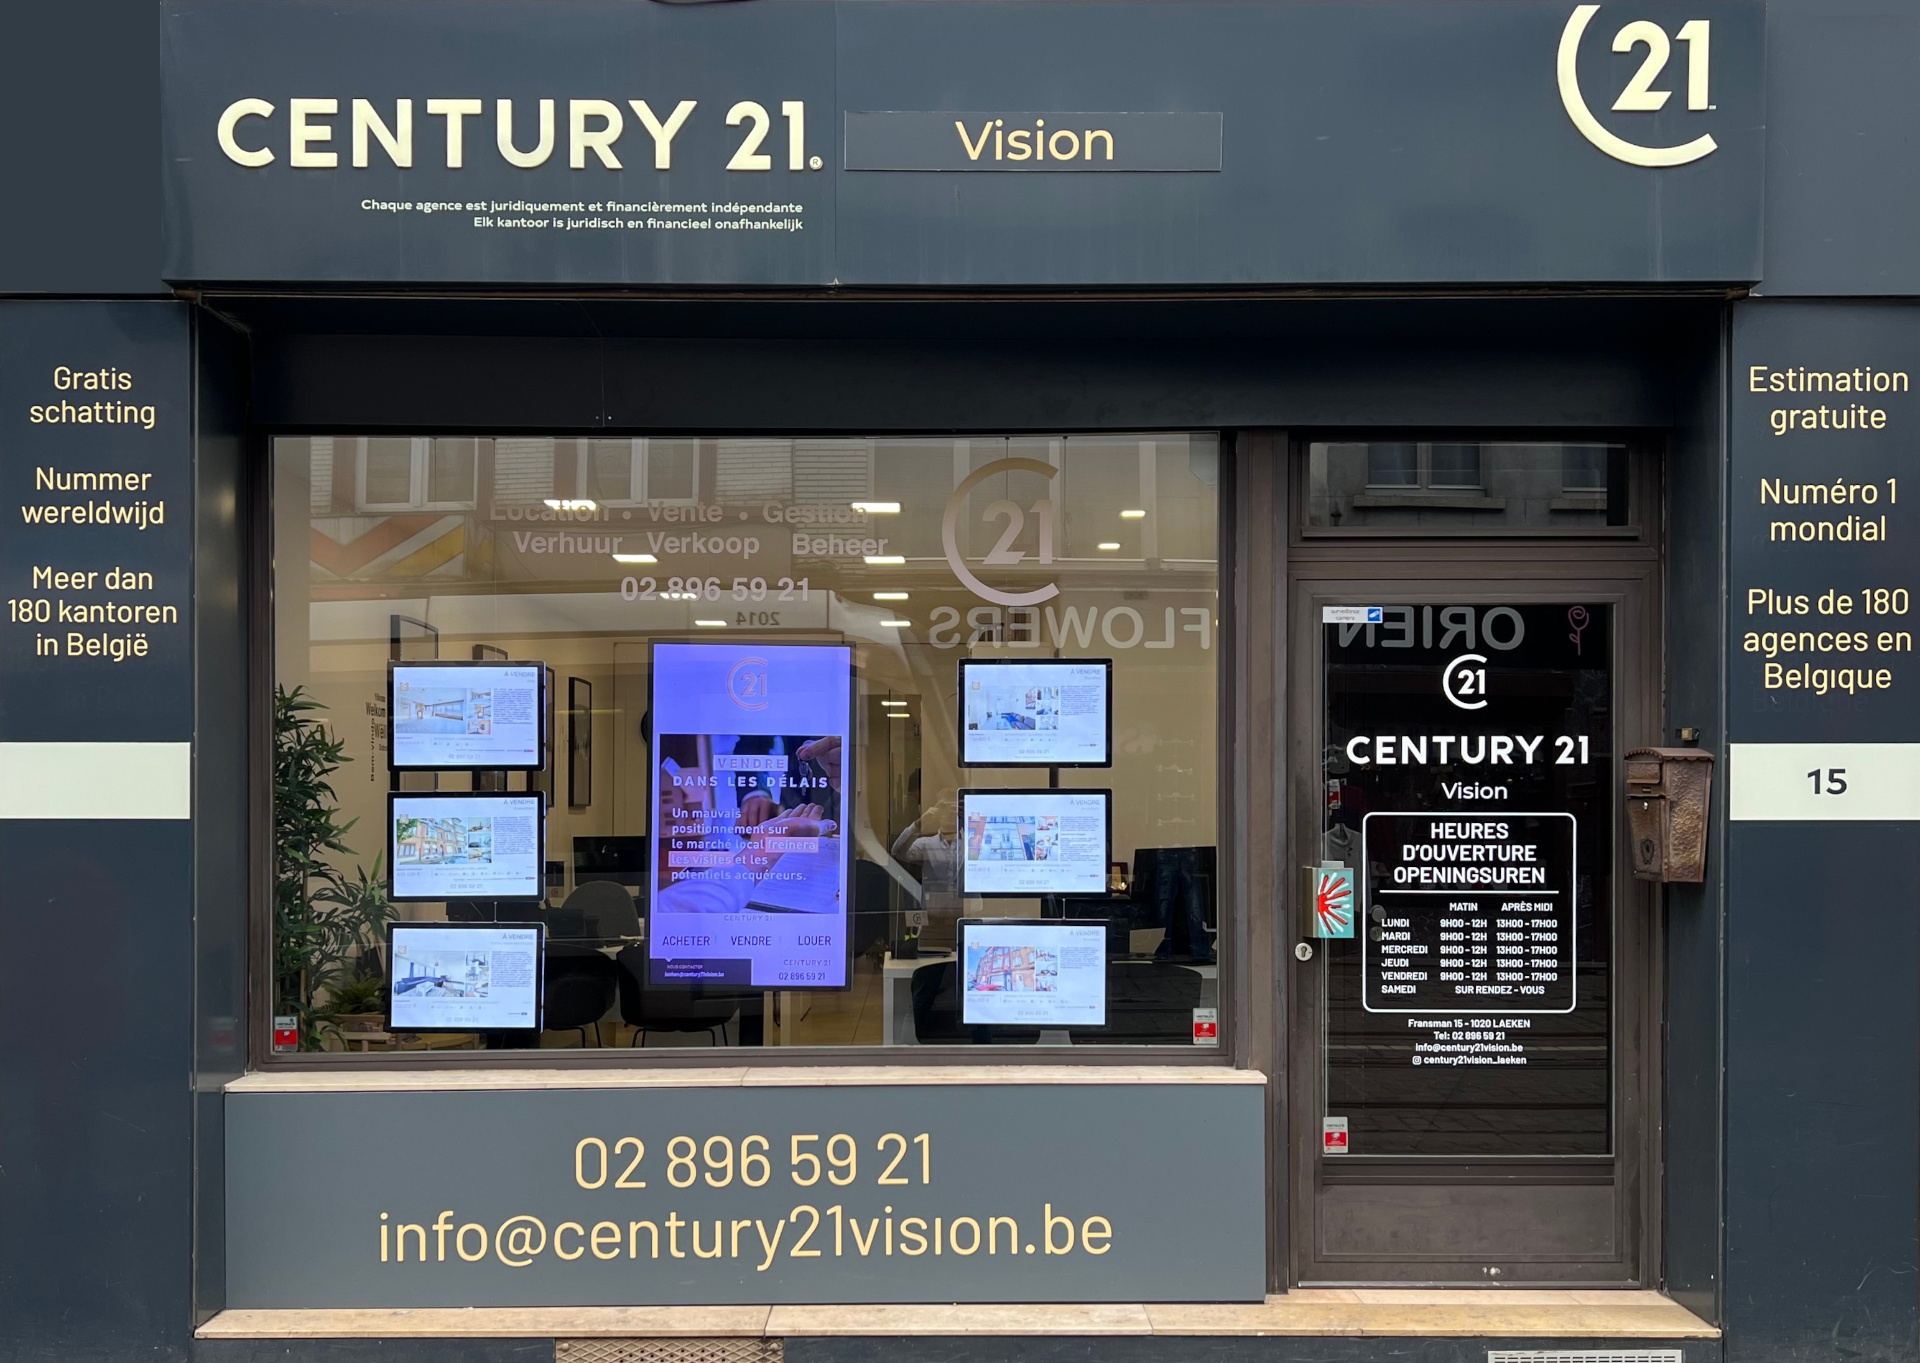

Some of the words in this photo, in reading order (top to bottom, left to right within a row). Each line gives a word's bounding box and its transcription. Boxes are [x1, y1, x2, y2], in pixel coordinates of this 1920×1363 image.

[217, 97, 699, 169] CENTURY
[955, 119, 1113, 160] Vision
[362, 199, 412, 212] Chaque
[416, 202, 462, 213] agence
[466, 201, 487, 210] est
[490, 201, 584, 214] juridiquement
[589, 202, 602, 211] et
[606, 201, 707, 212] financièrement
[712, 202, 803, 215] indépendante
[474, 217, 493, 227] Elk
[498, 217, 549, 227] kantoor
[553, 218, 563, 227] is
[566, 217, 623, 230] juridisch
[647, 218, 711, 229] financieel
[715, 219, 803, 231] onafhankelijk
[55, 367, 131, 390] Gratis
[1750, 367, 1908, 391] Estimation
[30, 400, 154, 429] schatting
[1771, 404, 1886, 435] gratuite
[37, 467, 151, 490] Nummer
[1761, 478, 1877, 504] Numéro
[1887, 479, 1895, 503] 1
[22, 501, 163, 530] wereldwijd
[490, 502, 609, 522] Location
[648, 503, 723, 522] Vente
[762, 504, 868, 524] Gestion
[1771, 515, 1885, 541] mondial
[513, 532, 623, 554] Verhuur
[647, 532, 760, 559] Verkoop
[792, 534, 888, 556] Beheer
[34, 566, 98, 589] Meer
[105, 567, 152, 589] dan
[620, 577, 657, 601] 02
[667, 577, 720, 601] 896
[731, 577, 767, 601] 59
[777, 577, 810, 601] 21
[1749, 589, 1809, 614] Plus
[1818, 589, 1852, 614] de
[1862, 589, 1908, 614] 180
[8, 599, 50, 622] 180
[59, 600, 176, 623] kantoren
[37, 633, 58, 655] in
[68, 633, 148, 661] België
[1744, 633, 1868, 658] agences
[1878, 632, 1911, 651] en
[1347, 736, 1544, 765] CENTURY
[1555, 736, 1588, 764] 21
[717, 758, 785, 769] VENDRE
[673, 776, 718, 786] DANS
[728, 777, 757, 787] LES
[766, 774, 828, 788] DÉLAIS
[1808, 769, 1847, 794] 15
[1441, 782, 1507, 799] Vision
[672, 808, 689, 818] Un
[692, 808, 741, 818] mauvais
[672, 824, 765, 835] positionnement
[1431, 823, 1508, 839] HEURES
[672, 839, 683, 849] le
[687, 839, 732, 849] marché
[735, 839, 764, 850] local
[768, 840, 816, 850] freinera
[672, 855, 690, 864] les
[693, 855, 732, 865] visites
[735, 856, 746, 865] et
[750, 855, 768, 865] les
[1403, 845, 1536, 861] D'OUVERTURE
[671, 870, 731, 882] potentiels
[735, 870, 806, 882] acquéreurs.
[1394, 867, 1544, 883] OPENINGSUREN
[1449, 903, 1478, 911] MATIN
[1501, 901, 1532, 911] APRÈS
[1534, 903, 1553, 911] MIDI
[1382, 919, 1409, 927] LUNDI
[1440, 919, 1464, 928] 9H00
[1472, 919, 1487, 928] 12H
[1496, 919, 1523, 928] 13H00
[1531, 919, 1557, 928] 17H00
[663, 936, 710, 945] ACHETER
[731, 936, 771, 945] VENDRE
[798, 936, 831, 945] LOUER
[1382, 932, 1410, 941] MARDI
[1440, 933, 1464, 941] 9H00
[1472, 933, 1487, 941] 12H
[1496, 933, 1523, 941] 13H00
[1531, 933, 1557, 941] 17H00
[1382, 945, 1428, 954] MERCREDI
[1440, 946, 1464, 954] 9H00
[1472, 946, 1487, 954] 12H
[1496, 946, 1523, 954] 13H00
[1531, 946, 1557, 954] 17H00
[1382, 959, 1409, 967] JEUDI
[1440, 959, 1464, 967] 9H00
[1472, 959, 1487, 967] 12H
[1496, 959, 1523, 968] 13H00
[1531, 959, 1557, 968] 17H00
[1382, 972, 1428, 980] VENDREDI
[1440, 972, 1464, 981] 9H00
[1472, 972, 1487, 981] 12H
[1496, 972, 1523, 981] 13H00
[1531, 972, 1557, 981] 17H00
[1382, 985, 1416, 993] SAMEDI
[1455, 986, 1475, 994] SUR
[1476, 986, 1512, 994] RENDEZ
[1520, 986, 1545, 994] VOUS
[1408, 1019, 1452, 1028] Fransman
[1454, 1020, 1463, 1028] 15
[1471, 1020, 1491, 1028] 1020
[1493, 1020, 1530, 1028] LAEKEN
[1434, 1032, 1450, 1040] Tel:
[1452, 1032, 1464, 1040] 02
[1465, 1032, 1483, 1040] 896
[1484, 1032, 1495, 1040] 59
[1496, 1032, 1505, 1040] 21
[1416, 1043, 1523, 1053] info@century21vision.be
[576, 1137, 646, 1189] 02
[667, 1135, 770, 1187] 896
[792, 1134, 856, 1186] 59
[878, 1133, 929, 1184] 21
[381, 1204, 1111, 1271] info@century21vision.be
